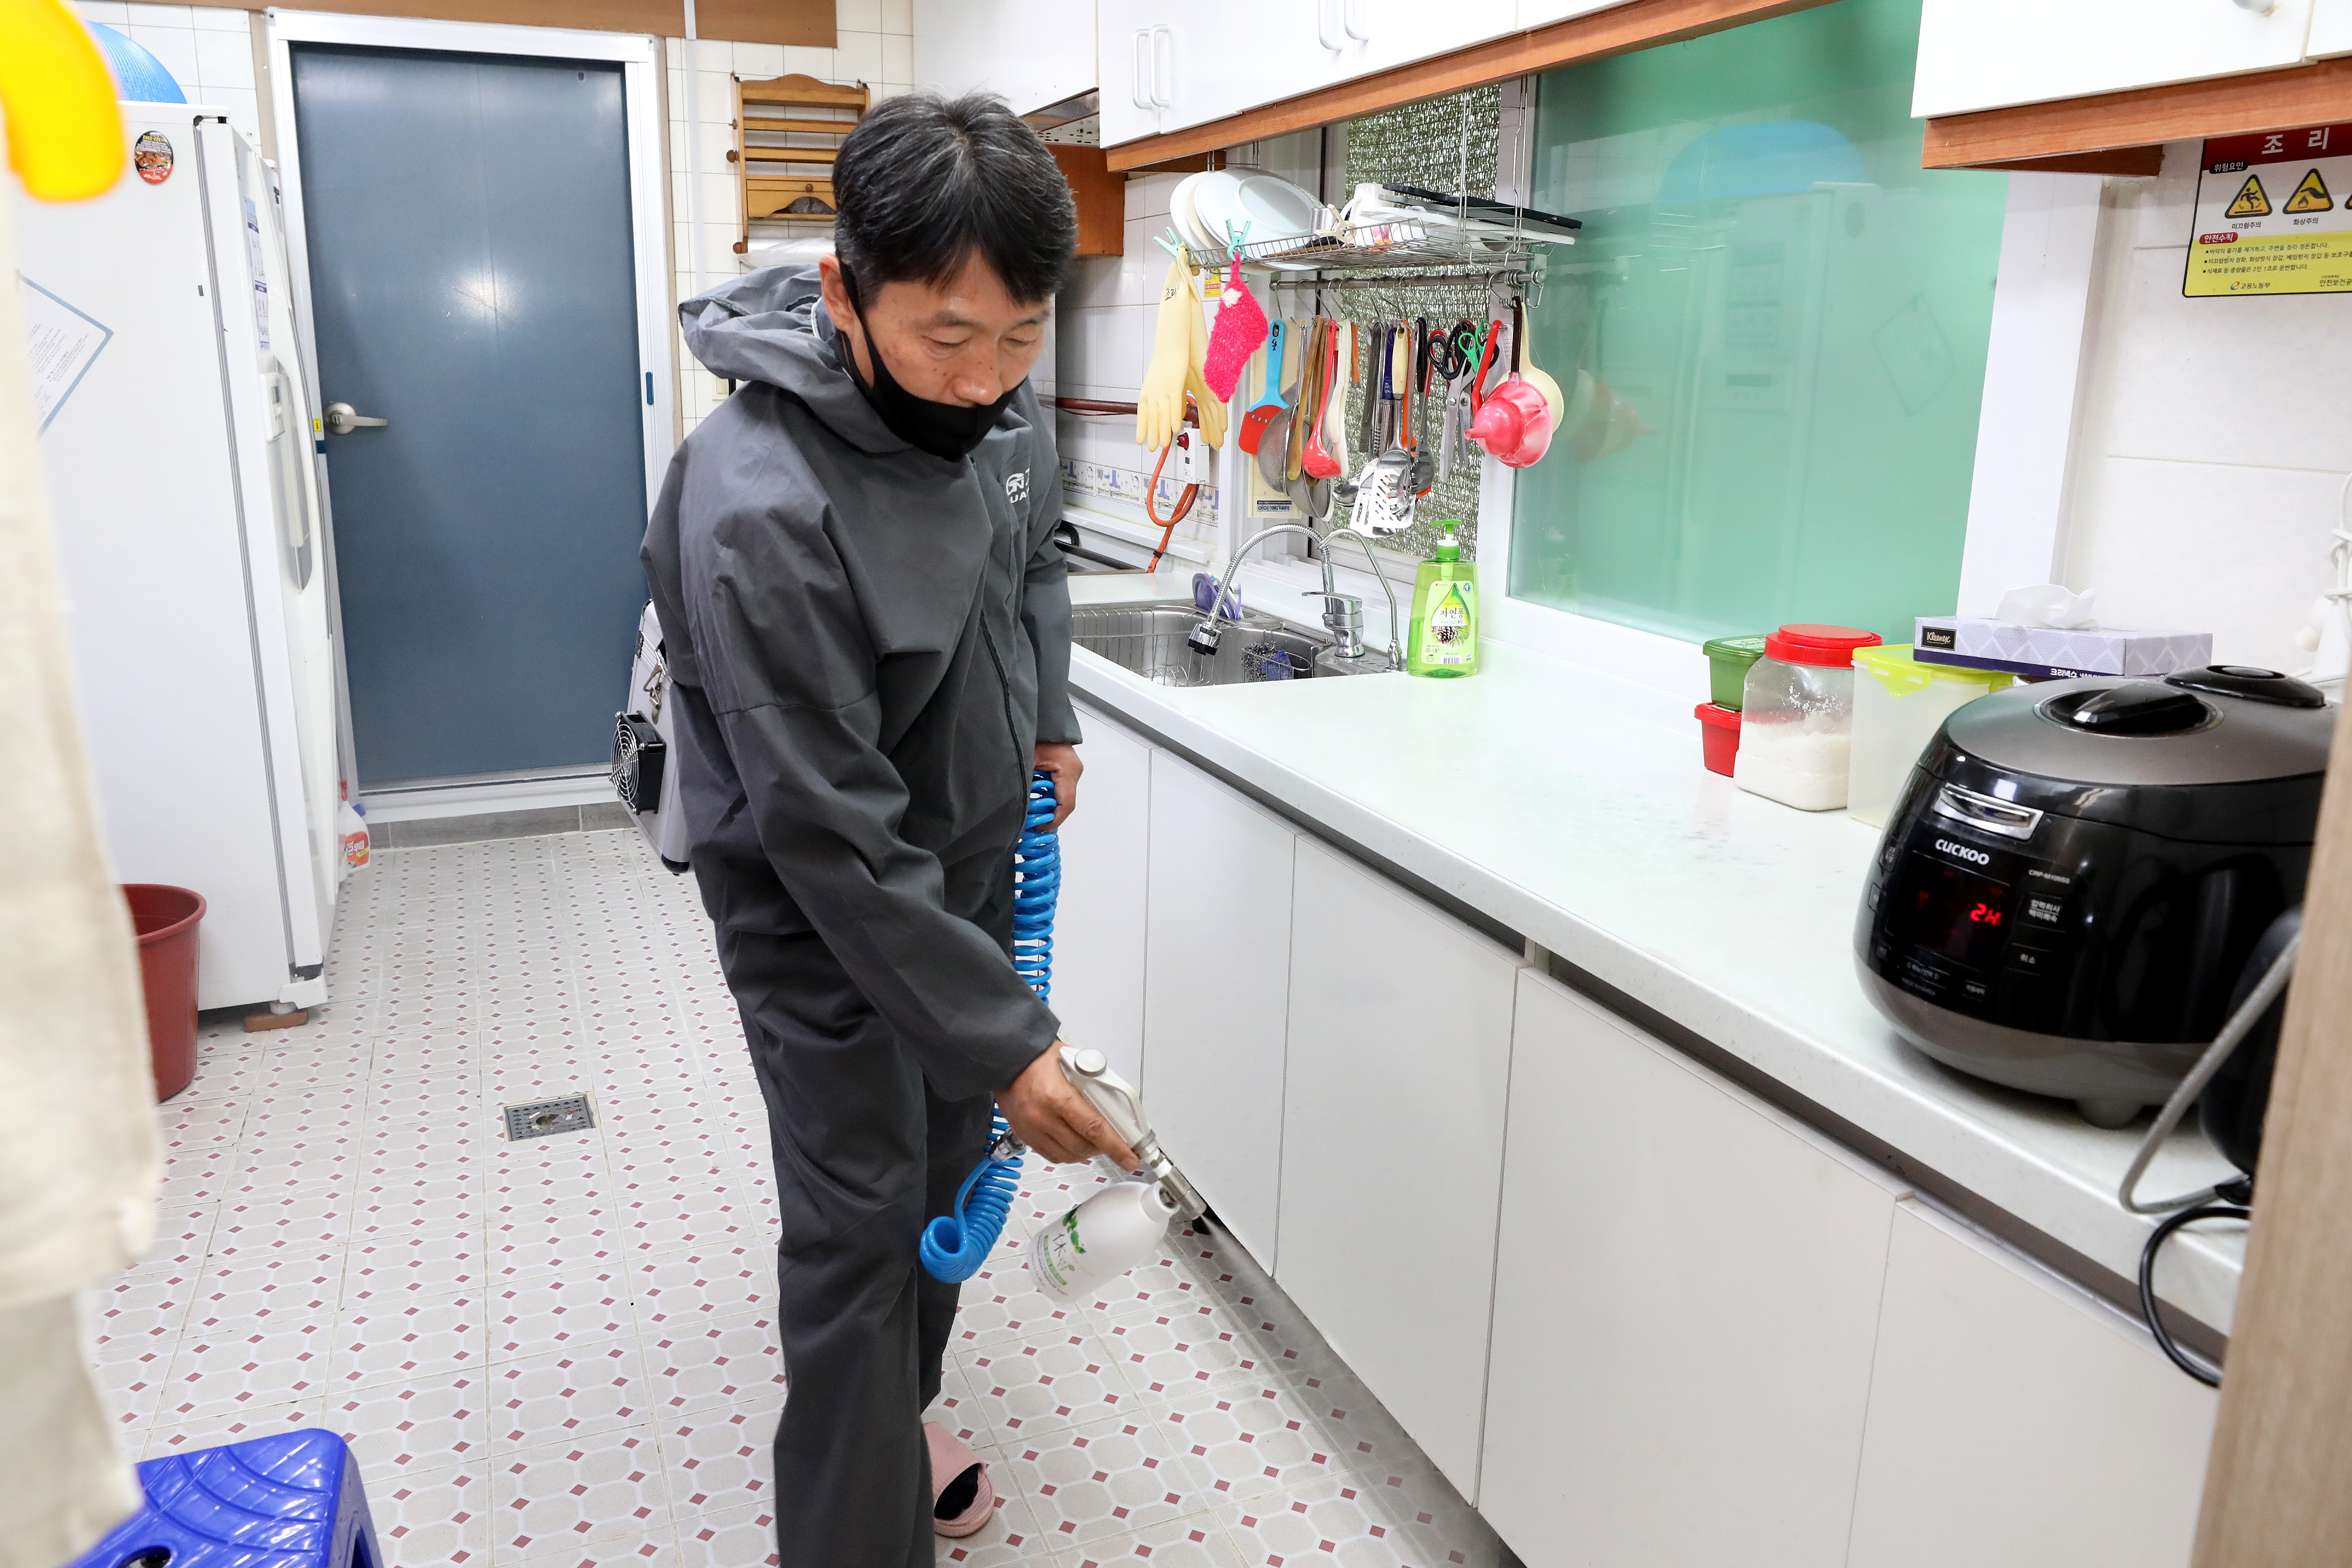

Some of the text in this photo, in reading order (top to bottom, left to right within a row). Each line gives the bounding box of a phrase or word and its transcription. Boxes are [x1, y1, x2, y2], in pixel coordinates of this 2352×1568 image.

[2261, 127, 2330, 154] 조 리
[2213, 161, 2244, 172] 위험요인
[2232, 217, 2319, 230] 미끄럼주의 화상주의
[2204, 233, 2233, 243] 안전수칙
[1440, 607, 1465, 618] 자연퐁
[1927, 632, 1951, 644] Kleenex
[2050, 668, 2078, 678] 크리넥스
[1935, 838, 1990, 865] CUCKOO
